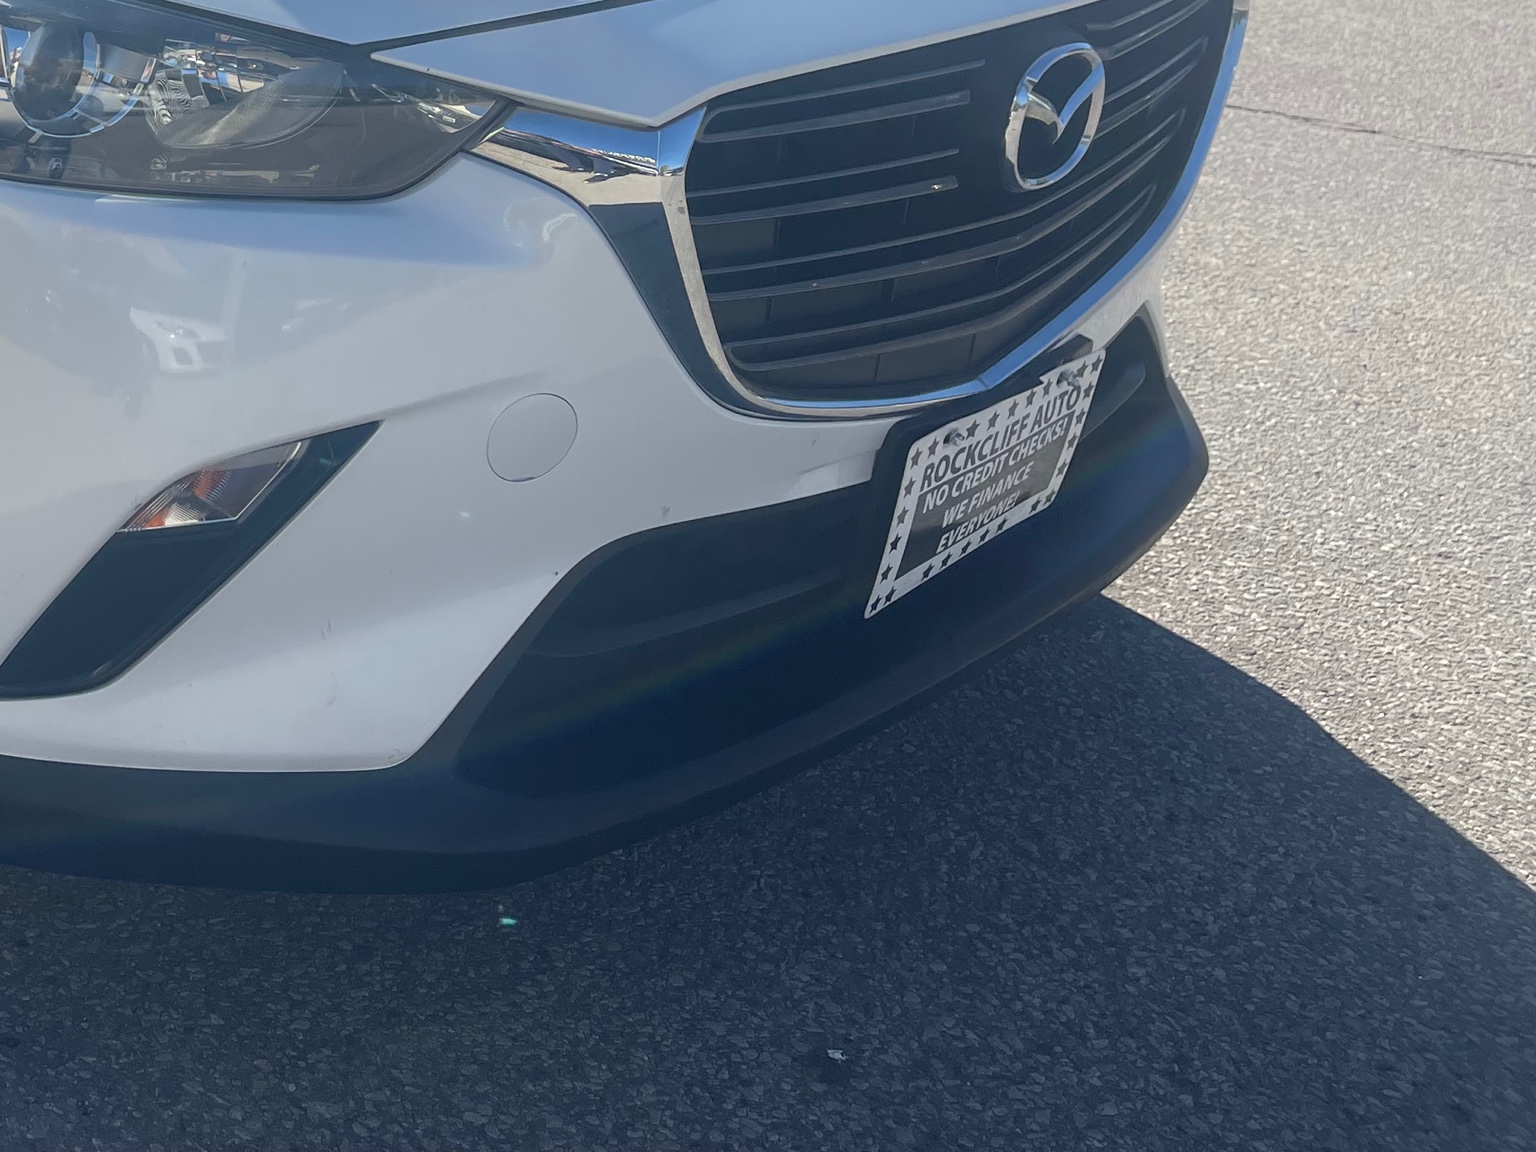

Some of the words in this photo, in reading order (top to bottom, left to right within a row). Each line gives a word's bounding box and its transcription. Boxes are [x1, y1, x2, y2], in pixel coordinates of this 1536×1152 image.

[920, 412, 1031, 493] ROCKCLIFF
[1030, 385, 1081, 433] AUTO
[923, 486, 949, 514] NO
[952, 453, 1010, 497] CREDIT
[1008, 417, 1069, 466] CHECKS!
[936, 490, 1021, 554] EVERYONE!
[942, 499, 969, 528] WE
[967, 461, 1034, 514] FINANCE
